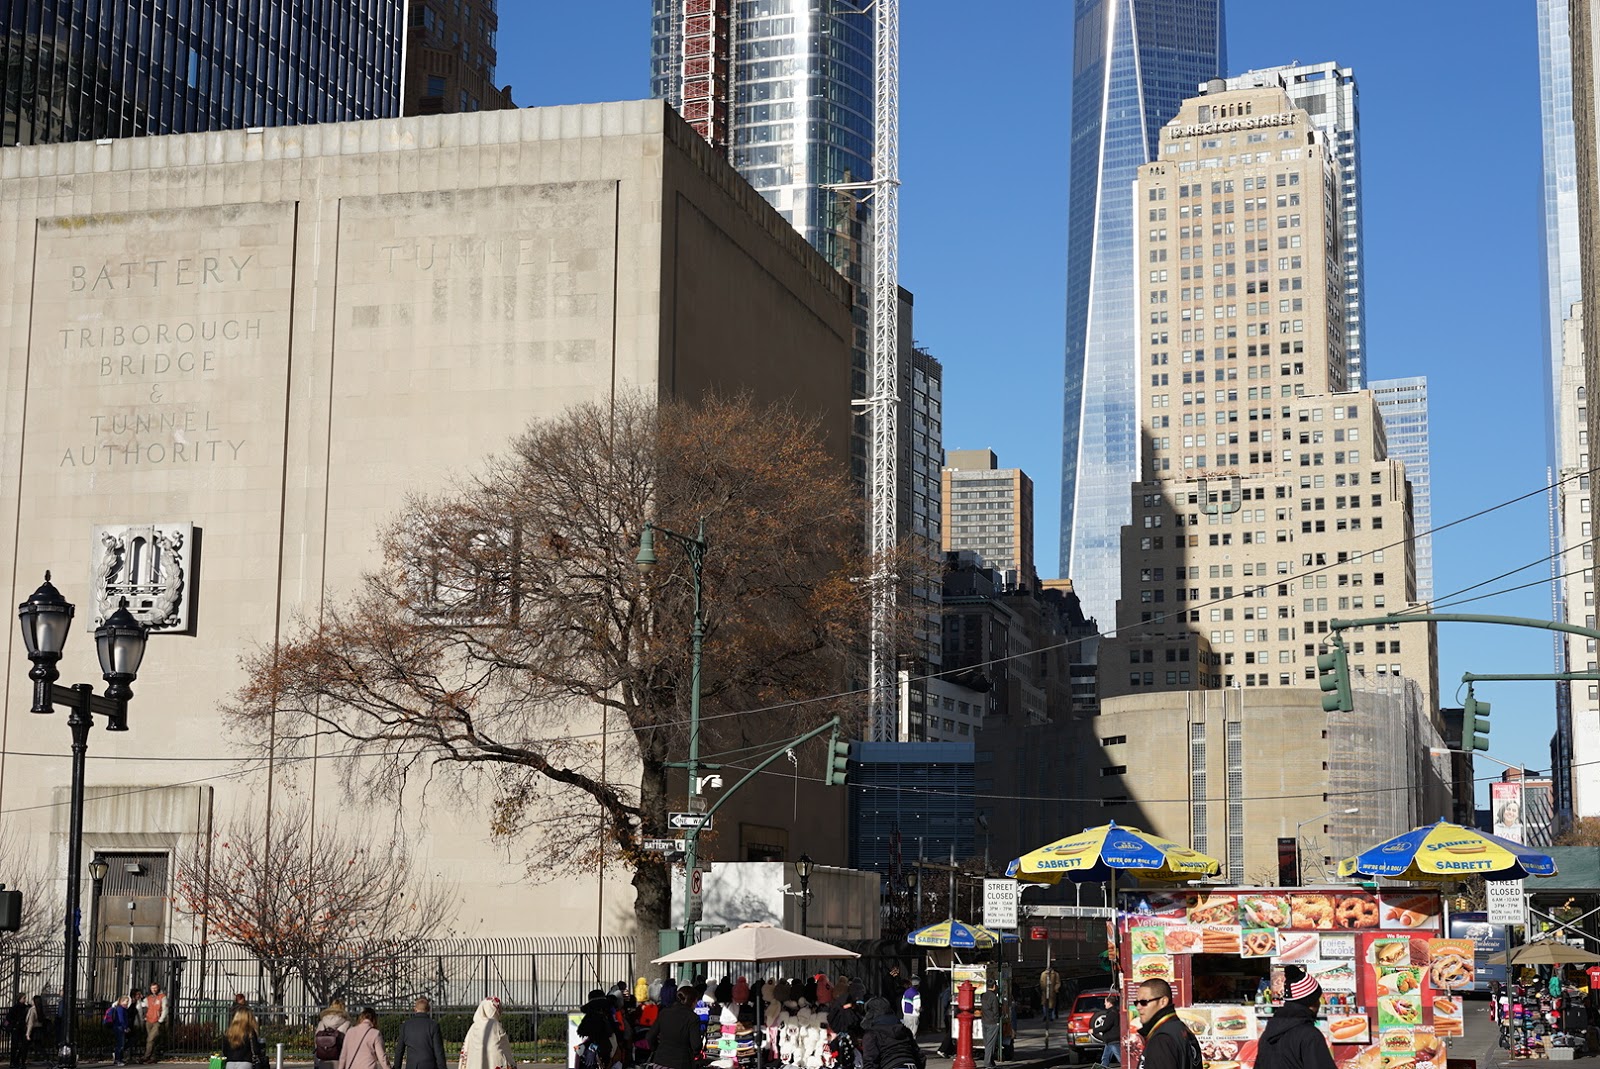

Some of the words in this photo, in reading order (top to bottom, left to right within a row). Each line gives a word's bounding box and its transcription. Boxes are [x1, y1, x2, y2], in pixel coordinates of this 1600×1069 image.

[1186, 120, 1243, 138] RECTOR
[1245, 111, 1297, 130] STREET
[381, 237, 569, 274] TUNNEL
[70, 254, 254, 293] BATTERY
[60, 318, 262, 350] TRIBOROUGH
[100, 350, 216, 377] BRIDGE
[149, 383, 164, 404] &
[90, 410, 220, 437] TUNNEL
[60, 439, 247, 468] AUTHORITY
[675, 817, 687, 825] ONE
[644, 842, 669, 850] BATTERY
[1427, 839, 1484, 851] SABRETT
[1036, 858, 1082, 869] SABRETT
[1436, 860, 1493, 870] SABRETT
[987, 883, 1014, 891] STREET
[1490, 888, 1521, 896] CLOSED
[987, 892, 1014, 900] CLOSED
[917, 936, 948, 945] SABRETT
